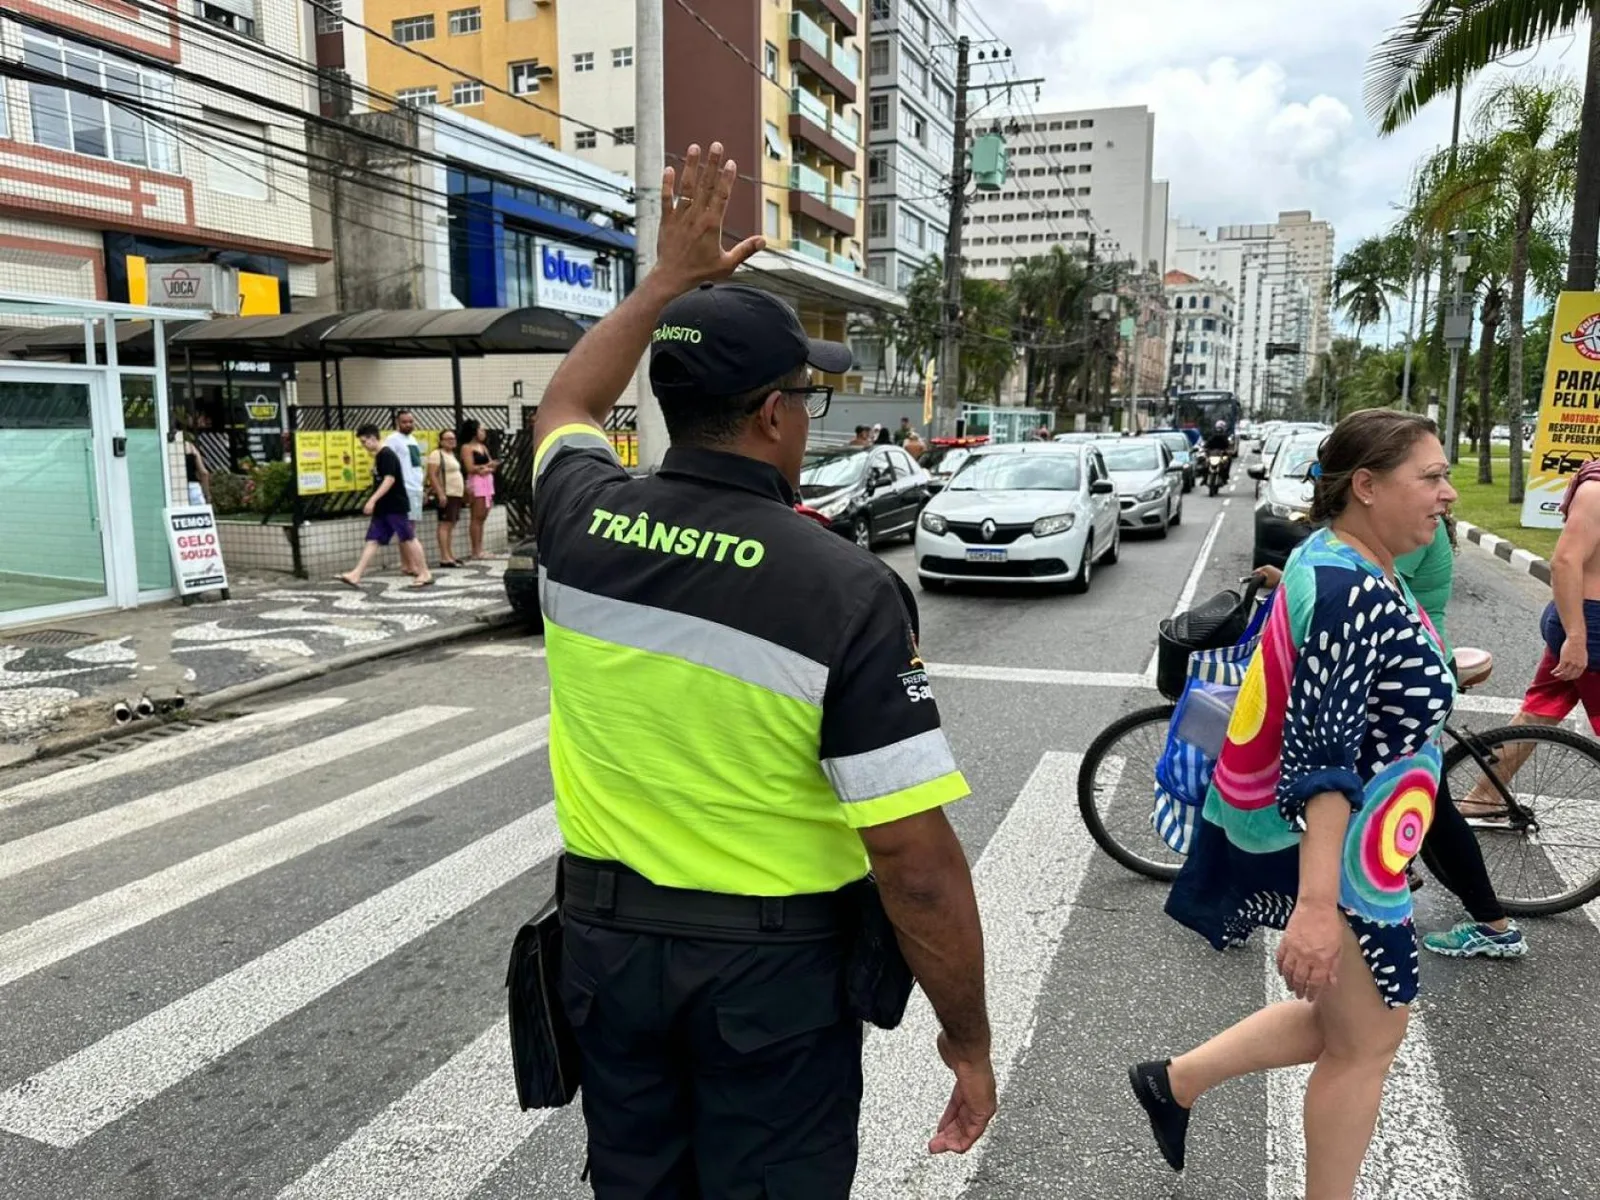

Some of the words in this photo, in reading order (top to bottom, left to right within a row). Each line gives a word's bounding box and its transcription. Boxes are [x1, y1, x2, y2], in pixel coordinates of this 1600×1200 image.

[169, 281, 194, 295] JOCA
[1553, 392, 1588, 408] PELA
[1548, 423, 1586, 433] RESPEITE
[1552, 434, 1562, 442] DE
[172, 516, 211, 528] TEMOS
[177, 534, 215, 548] GELO
[587, 508, 765, 568] TRÂNSITO
[180, 548, 218, 560] SOUZA
